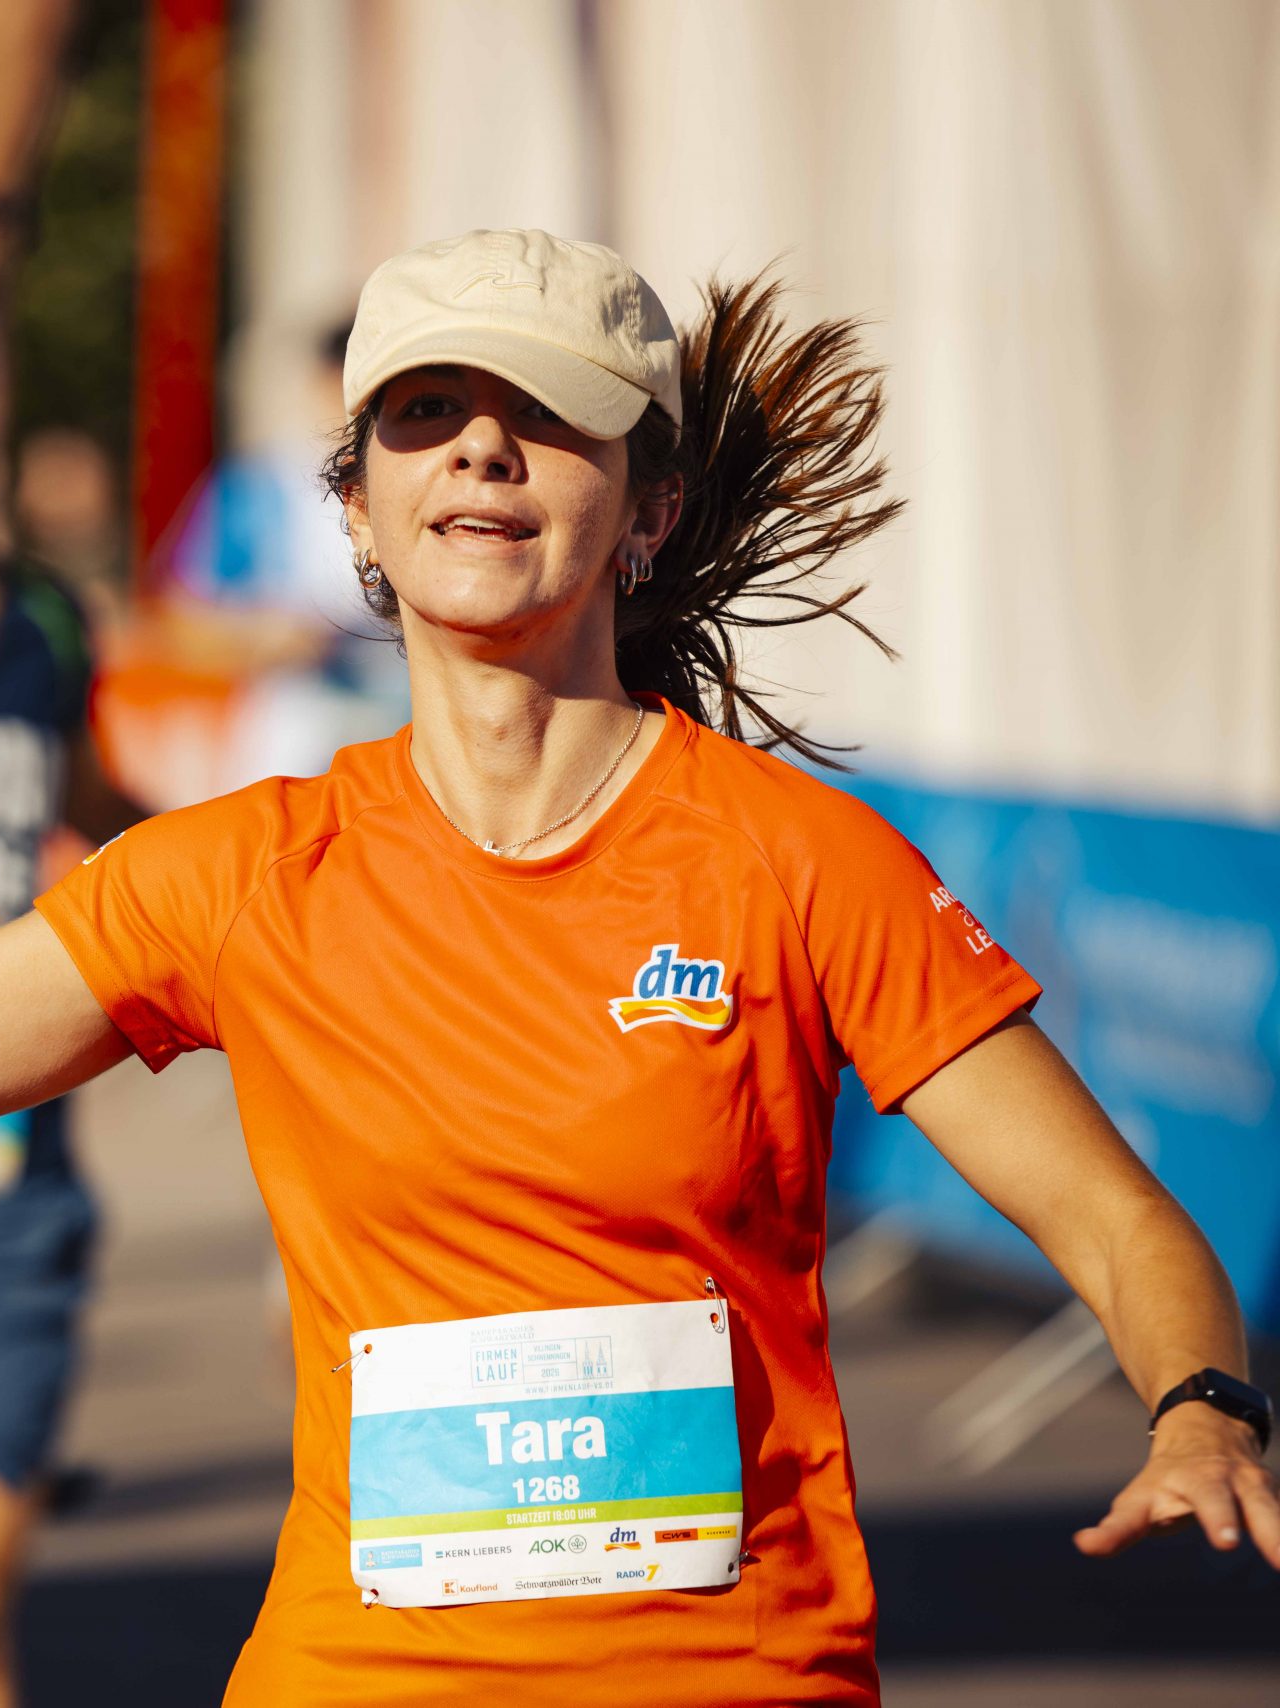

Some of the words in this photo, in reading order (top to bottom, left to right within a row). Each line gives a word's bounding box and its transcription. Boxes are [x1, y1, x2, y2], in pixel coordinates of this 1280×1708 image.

[929, 886, 958, 913] AR
[638, 948, 720, 1000] dm
[475, 1347, 518, 1362] FIRMEN
[475, 1362, 518, 1383] LAUF
[475, 1411, 607, 1465] Tara
[512, 1474, 580, 1503] 1268
[506, 1510, 551, 1525] STARTZEIT
[553, 1509, 576, 1521] 18:00
[578, 1507, 597, 1520] UHR
[610, 1527, 636, 1543] dm
[662, 1531, 691, 1540] CWS
[445, 1546, 470, 1559] KERN
[473, 1545, 512, 1557] LIEBERS
[528, 1538, 566, 1555] AOK
[616, 1569, 645, 1580] RADIO
[646, 1564, 659, 1582] 7
[460, 1582, 498, 1593] Kaufland
[515, 1577, 578, 1591] Schwarzwälder
[580, 1575, 602, 1587] Bote
